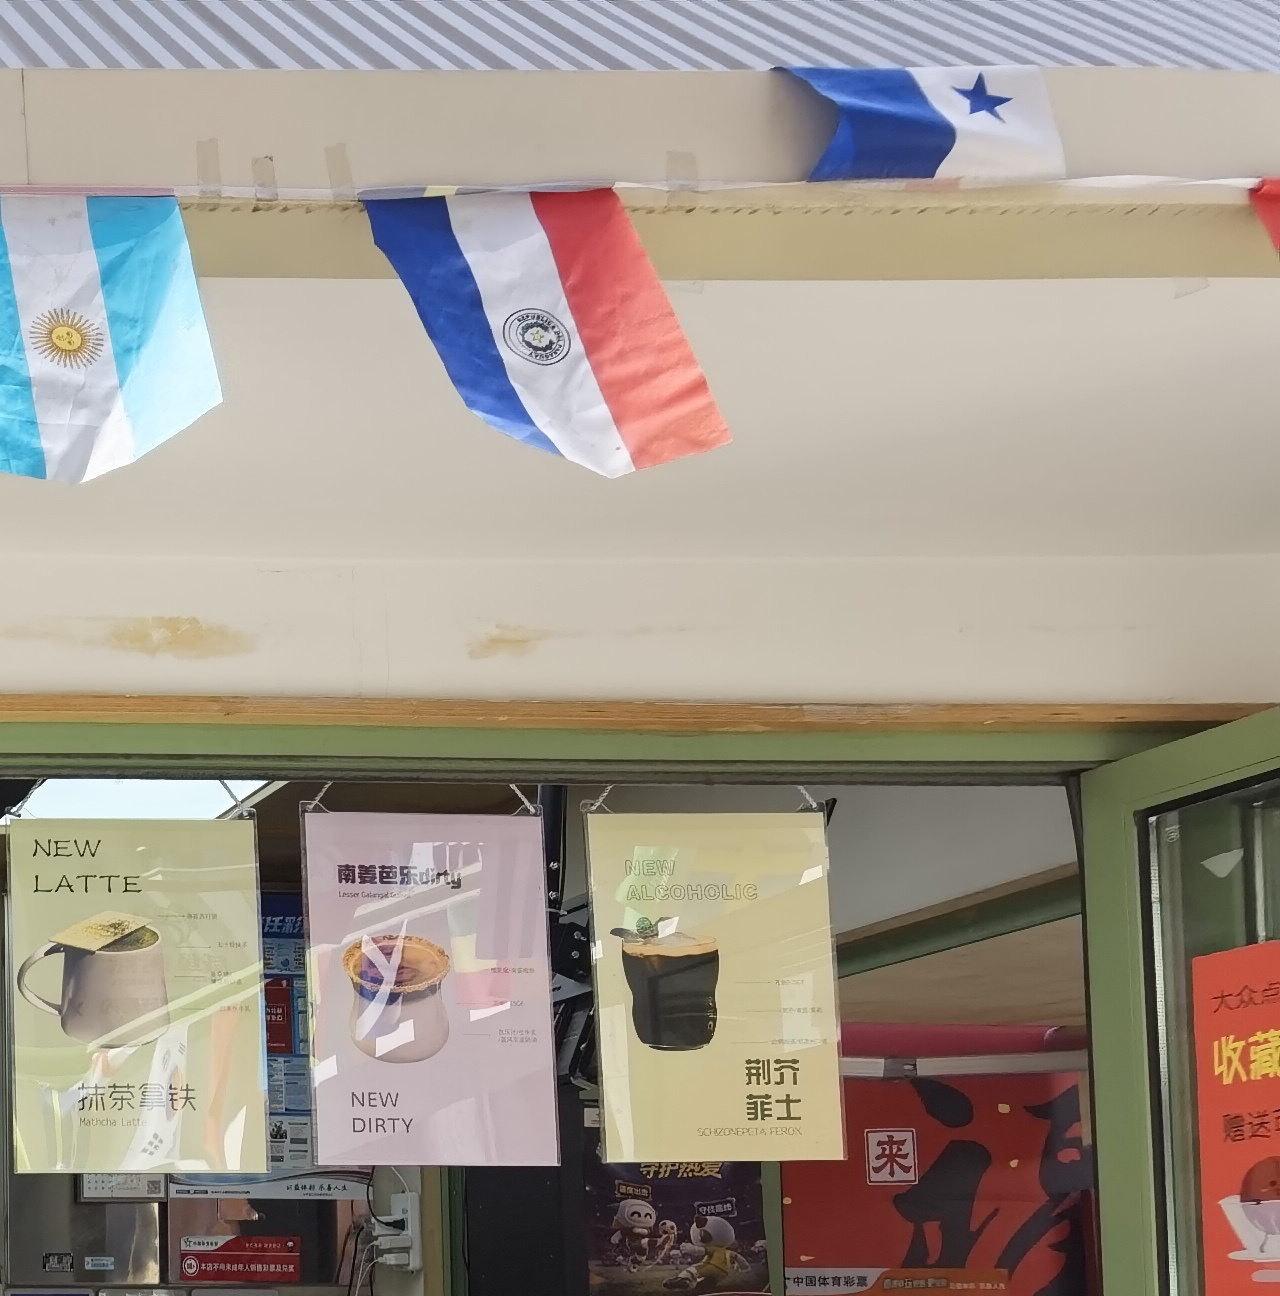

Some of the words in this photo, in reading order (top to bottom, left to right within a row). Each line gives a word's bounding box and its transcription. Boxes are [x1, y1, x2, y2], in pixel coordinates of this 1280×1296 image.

[32, 839, 101, 858] NEW
[625, 860, 675, 876] NEW
[33, 874, 142, 894] LATTE
[626, 883, 758, 901] ALCOHOLIC
[745, 1058, 800, 1085] 荆芥
[77, 1082, 196, 1113] 抹茶拿铁
[351, 1092, 400, 1108] NEW
[746, 1094, 802, 1120] 菲士
[352, 1117, 414, 1134] DIRTY
[872, 1135, 912, 1177] 来
[793, 1275, 869, 1287] 中国体育彩票
